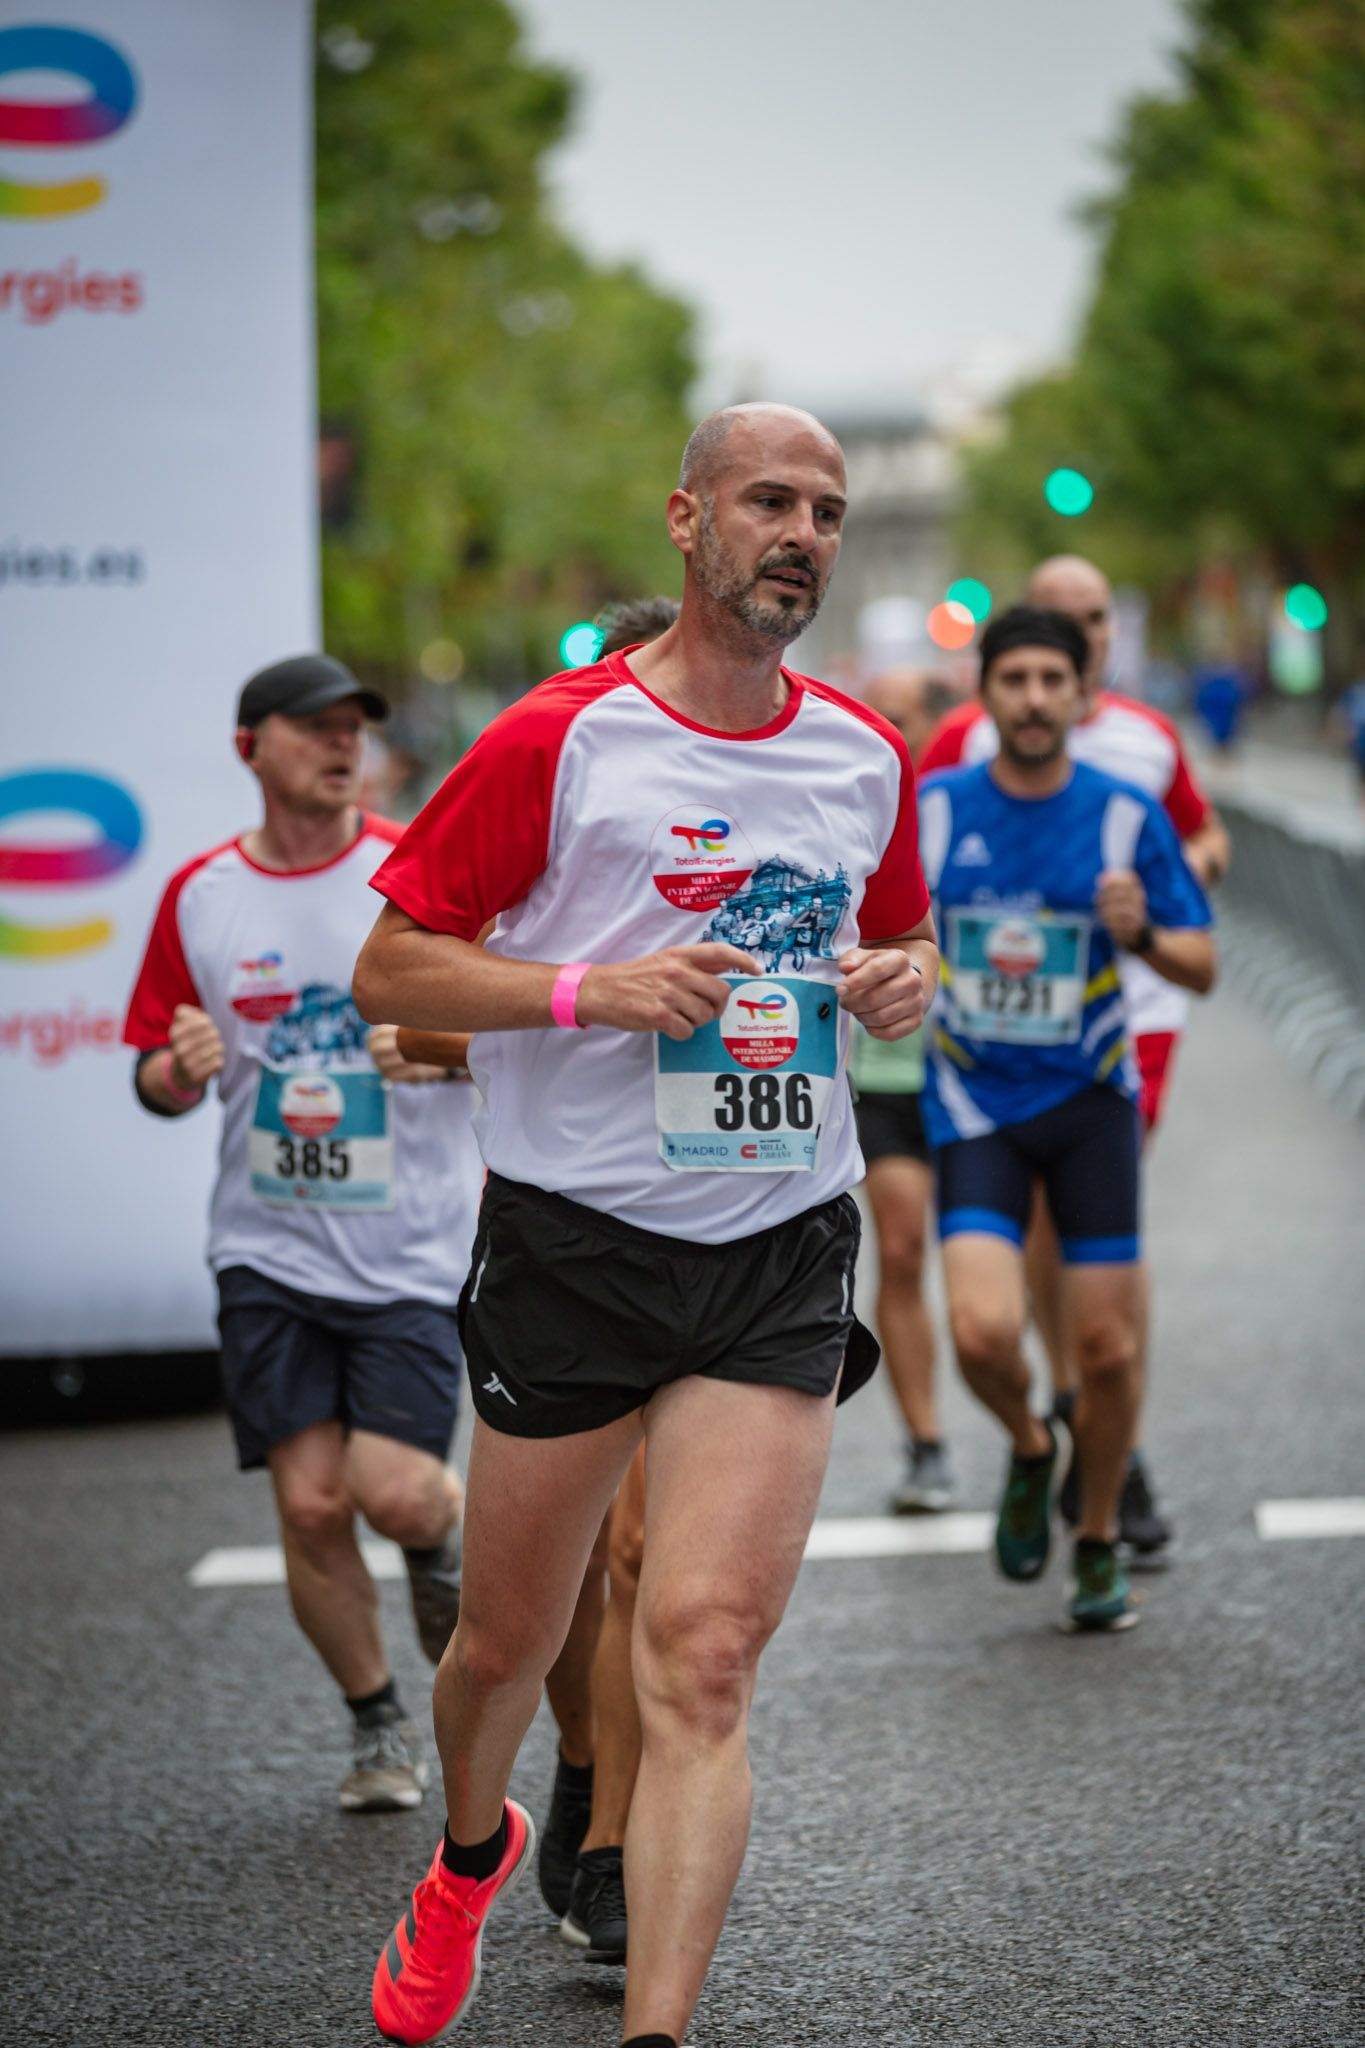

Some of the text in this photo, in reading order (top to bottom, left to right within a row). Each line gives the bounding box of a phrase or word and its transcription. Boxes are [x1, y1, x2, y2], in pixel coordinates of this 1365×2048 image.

[674, 856, 736, 867] TotalEnergies
[691, 876, 721, 885] MILLA
[737, 1023, 789, 1032] TotalEnergies
[740, 1055, 785, 1063] DE MADRID
[714, 1073, 813, 1131] 386
[681, 1145, 729, 1157] MADRID
[276, 1137, 350, 1180] 385
